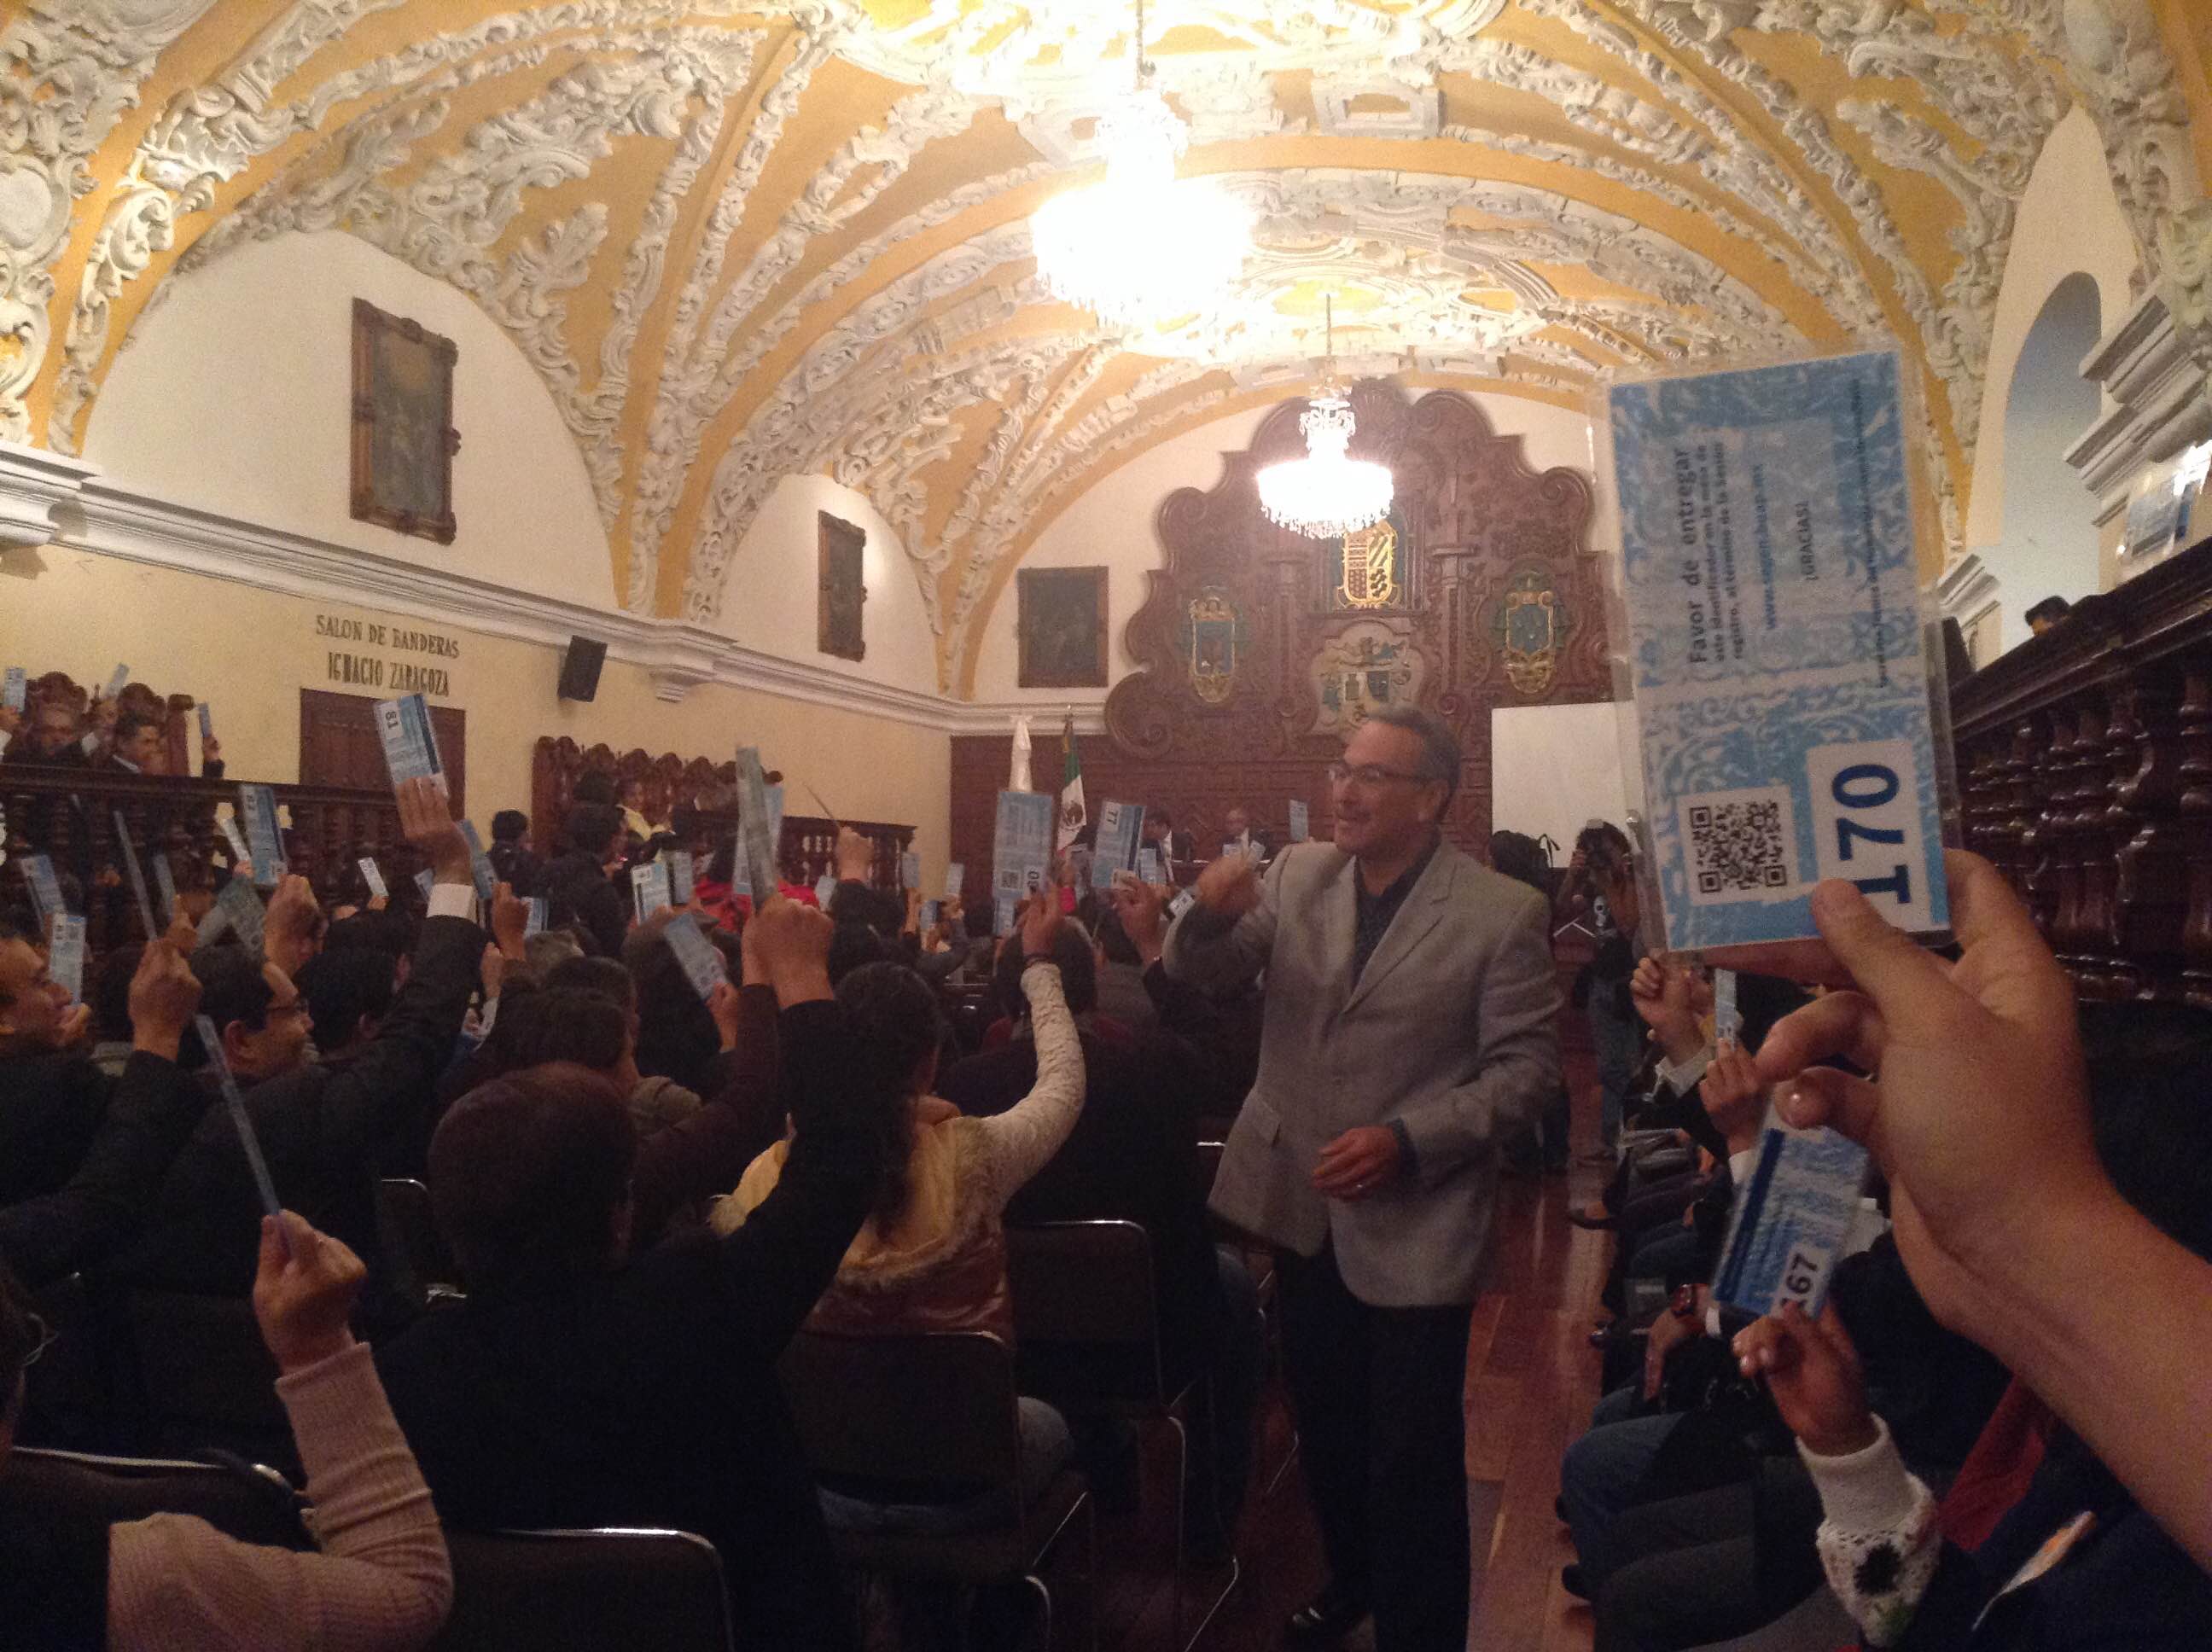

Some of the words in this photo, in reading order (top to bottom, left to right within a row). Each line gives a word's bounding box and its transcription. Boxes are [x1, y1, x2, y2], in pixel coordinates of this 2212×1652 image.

[1674, 447, 1697, 545] entregar
[1680, 559, 1701, 586] de
[316, 614, 363, 641] SALON
[369, 623, 387, 646] DE
[392, 628, 460, 659] BANDERAS
[1687, 600, 1708, 662] Favor
[329, 652, 383, 686] IGNACIO
[389, 662, 449, 696] ZARAGOZA
[1832, 764, 1911, 904] 170
